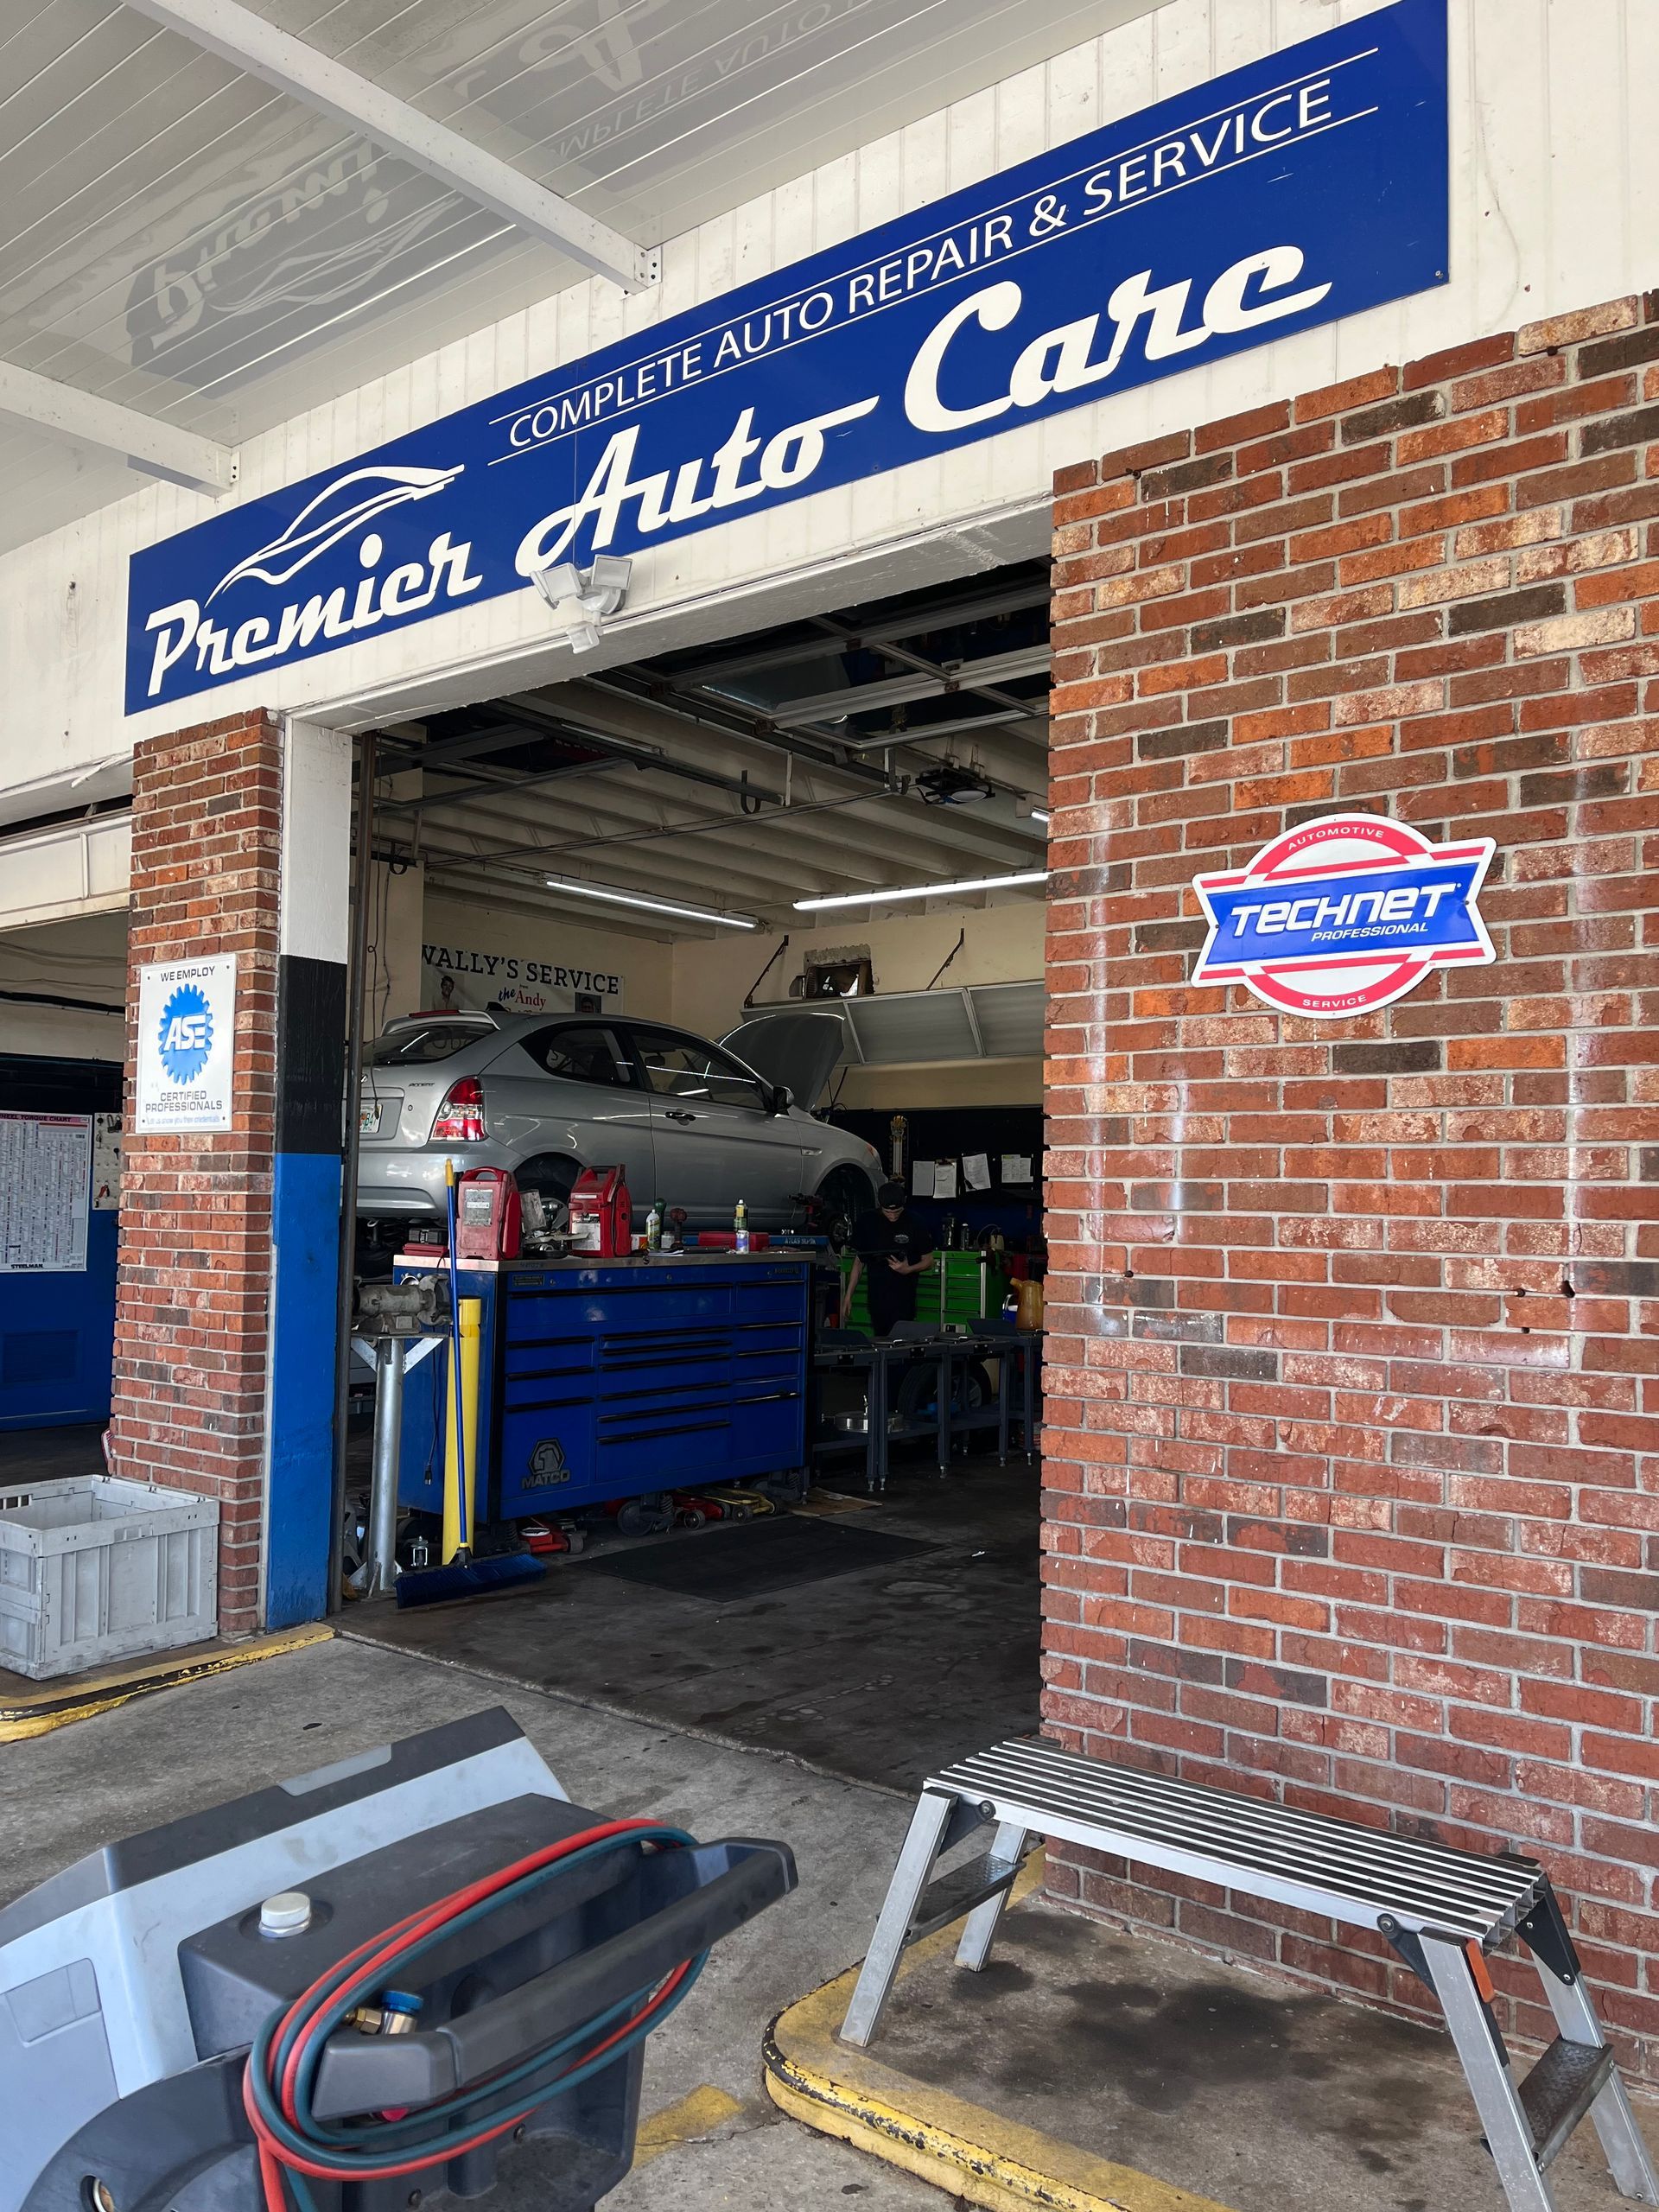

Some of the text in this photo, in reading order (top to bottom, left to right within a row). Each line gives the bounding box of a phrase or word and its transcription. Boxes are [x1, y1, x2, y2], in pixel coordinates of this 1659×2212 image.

[509, 79, 1332, 447] COMPLETE AUTO REPAIR & SERVICE
[144, 244, 1333, 696] Premier Auto Care
[1287, 826, 1385, 851] AUTOMOTIVE
[1311, 923, 1428, 943] PROFESSIONAL
[161, 966, 215, 982] WE EMPLOY
[422, 944, 619, 995] WALLY'S SERVICE
[499, 987, 546, 1010] the Andy
[1302, 995, 1367, 1007] SERVICE
[163, 1014, 206, 1051] ASE
[146, 1100, 222, 1113] PROFESSIONALS
[161, 1090, 207, 1102] CERTIFIED
[522, 1469, 570, 1490] MATCO
